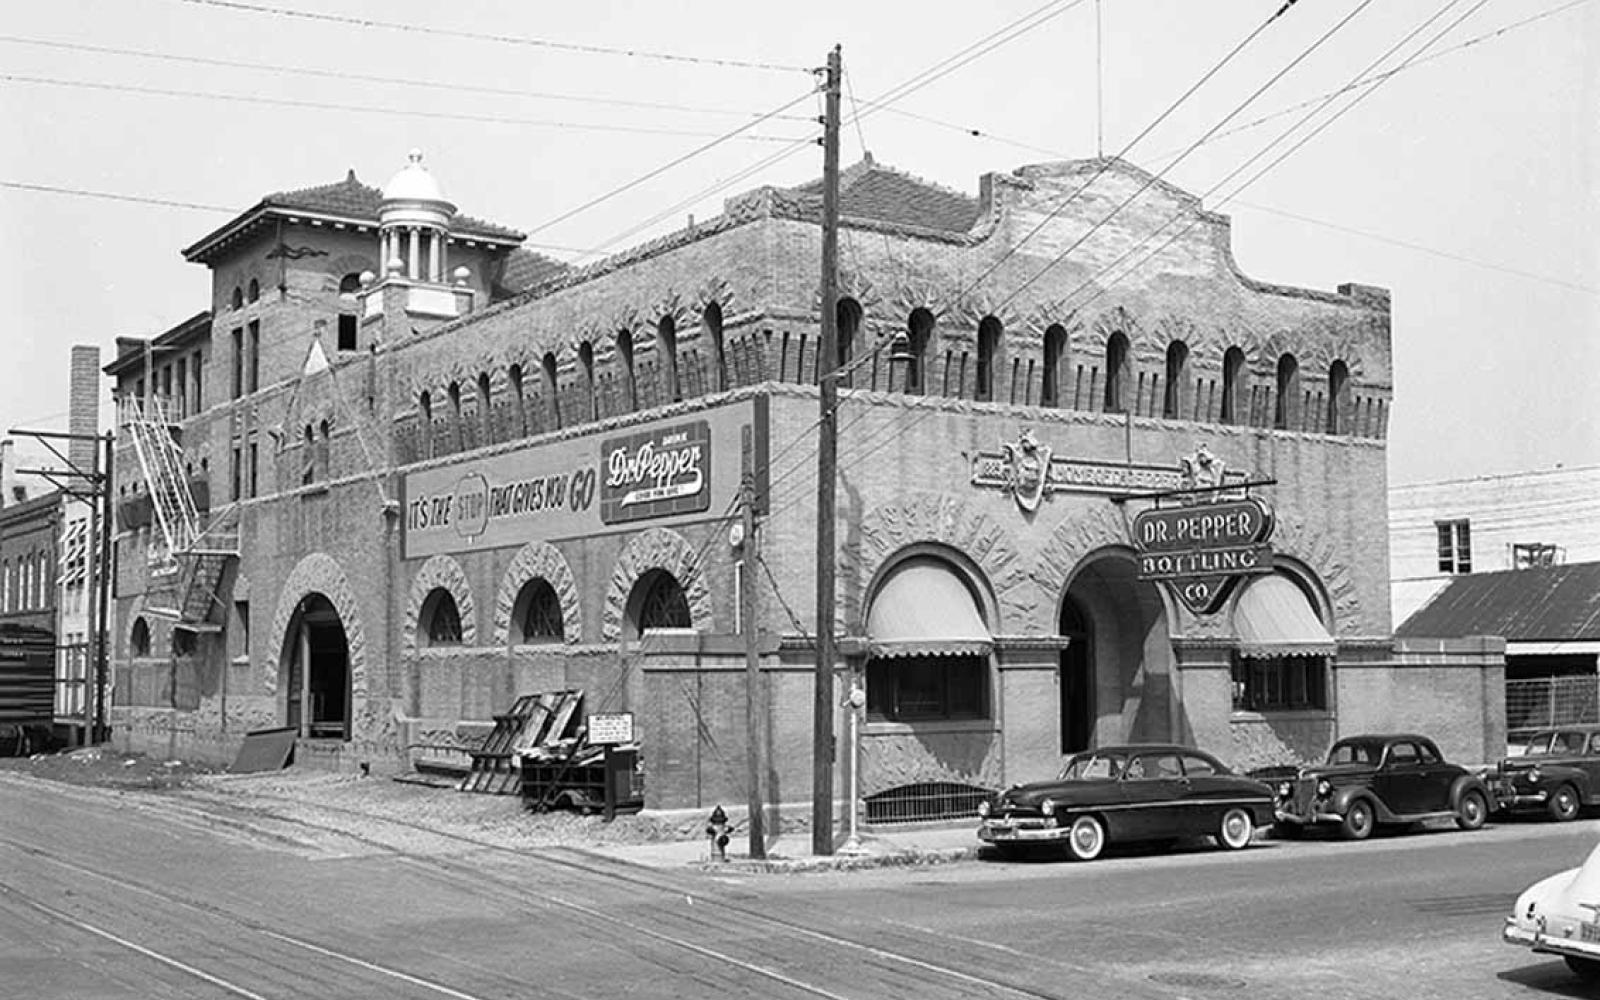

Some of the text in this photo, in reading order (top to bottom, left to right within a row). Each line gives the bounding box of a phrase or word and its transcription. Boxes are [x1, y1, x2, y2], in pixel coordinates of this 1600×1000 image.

[408, 468, 596, 530] IT'S THE STOP THAT GIVES YOU GO
[1176, 511, 1252, 541] PEPPER
[1143, 549, 1256, 574] BOTTLING
